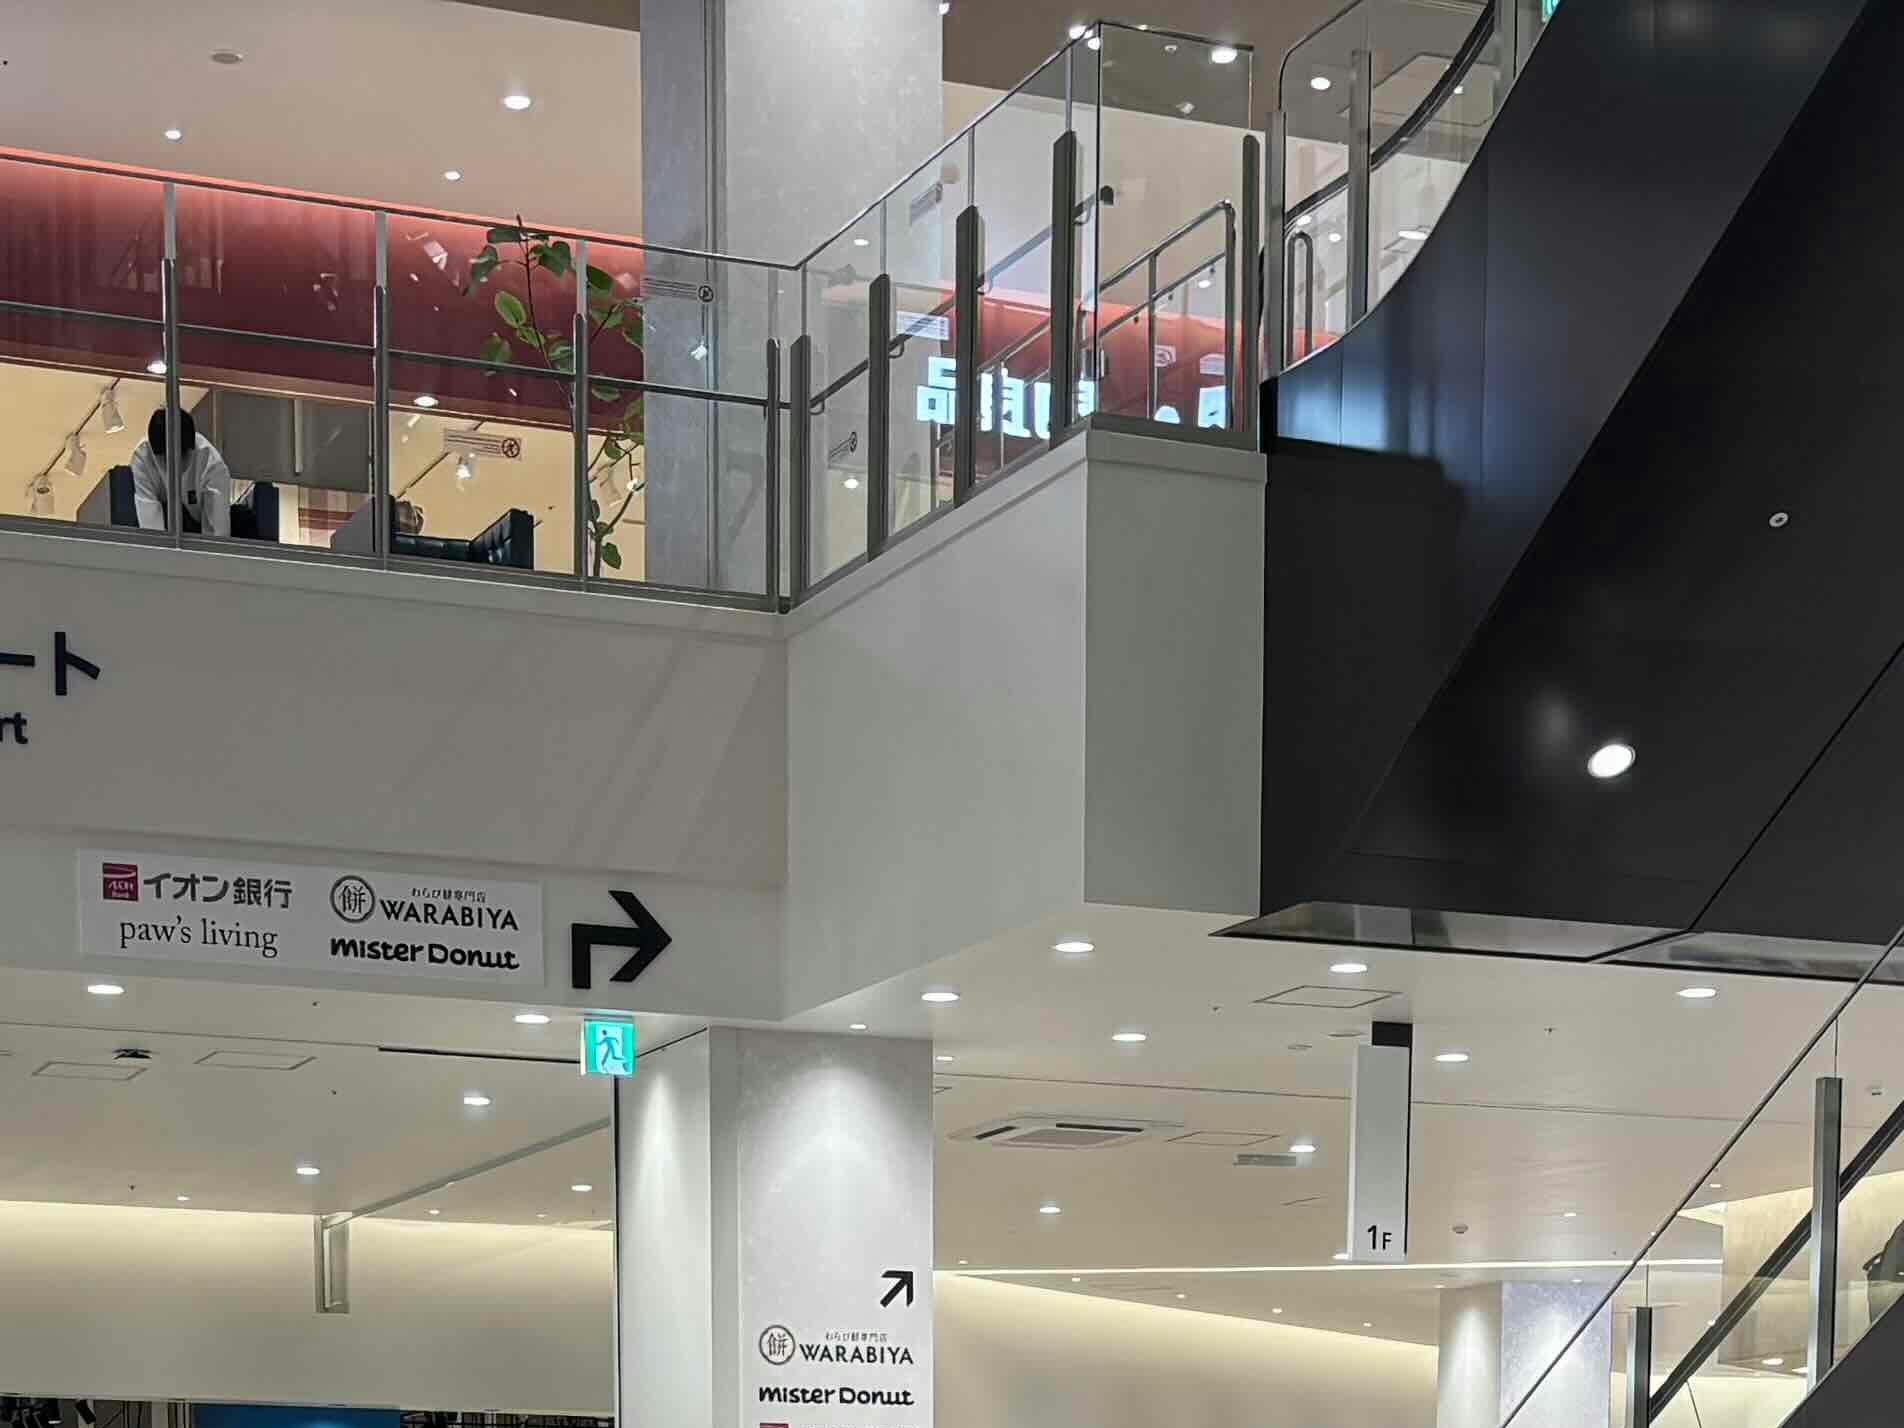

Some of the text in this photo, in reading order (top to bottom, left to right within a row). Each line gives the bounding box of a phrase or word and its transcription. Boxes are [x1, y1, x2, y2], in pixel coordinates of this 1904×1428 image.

[142, 870, 293, 909] イオン銀行
[380, 898, 519, 931] WARABIYA
[119, 915, 278, 958] paw's living
[428, 942, 521, 970] Donut
[1367, 1224, 1393, 1250] 1F
[799, 1343, 914, 1365] WARABIYA
[839, 1387, 915, 1405] Donut
